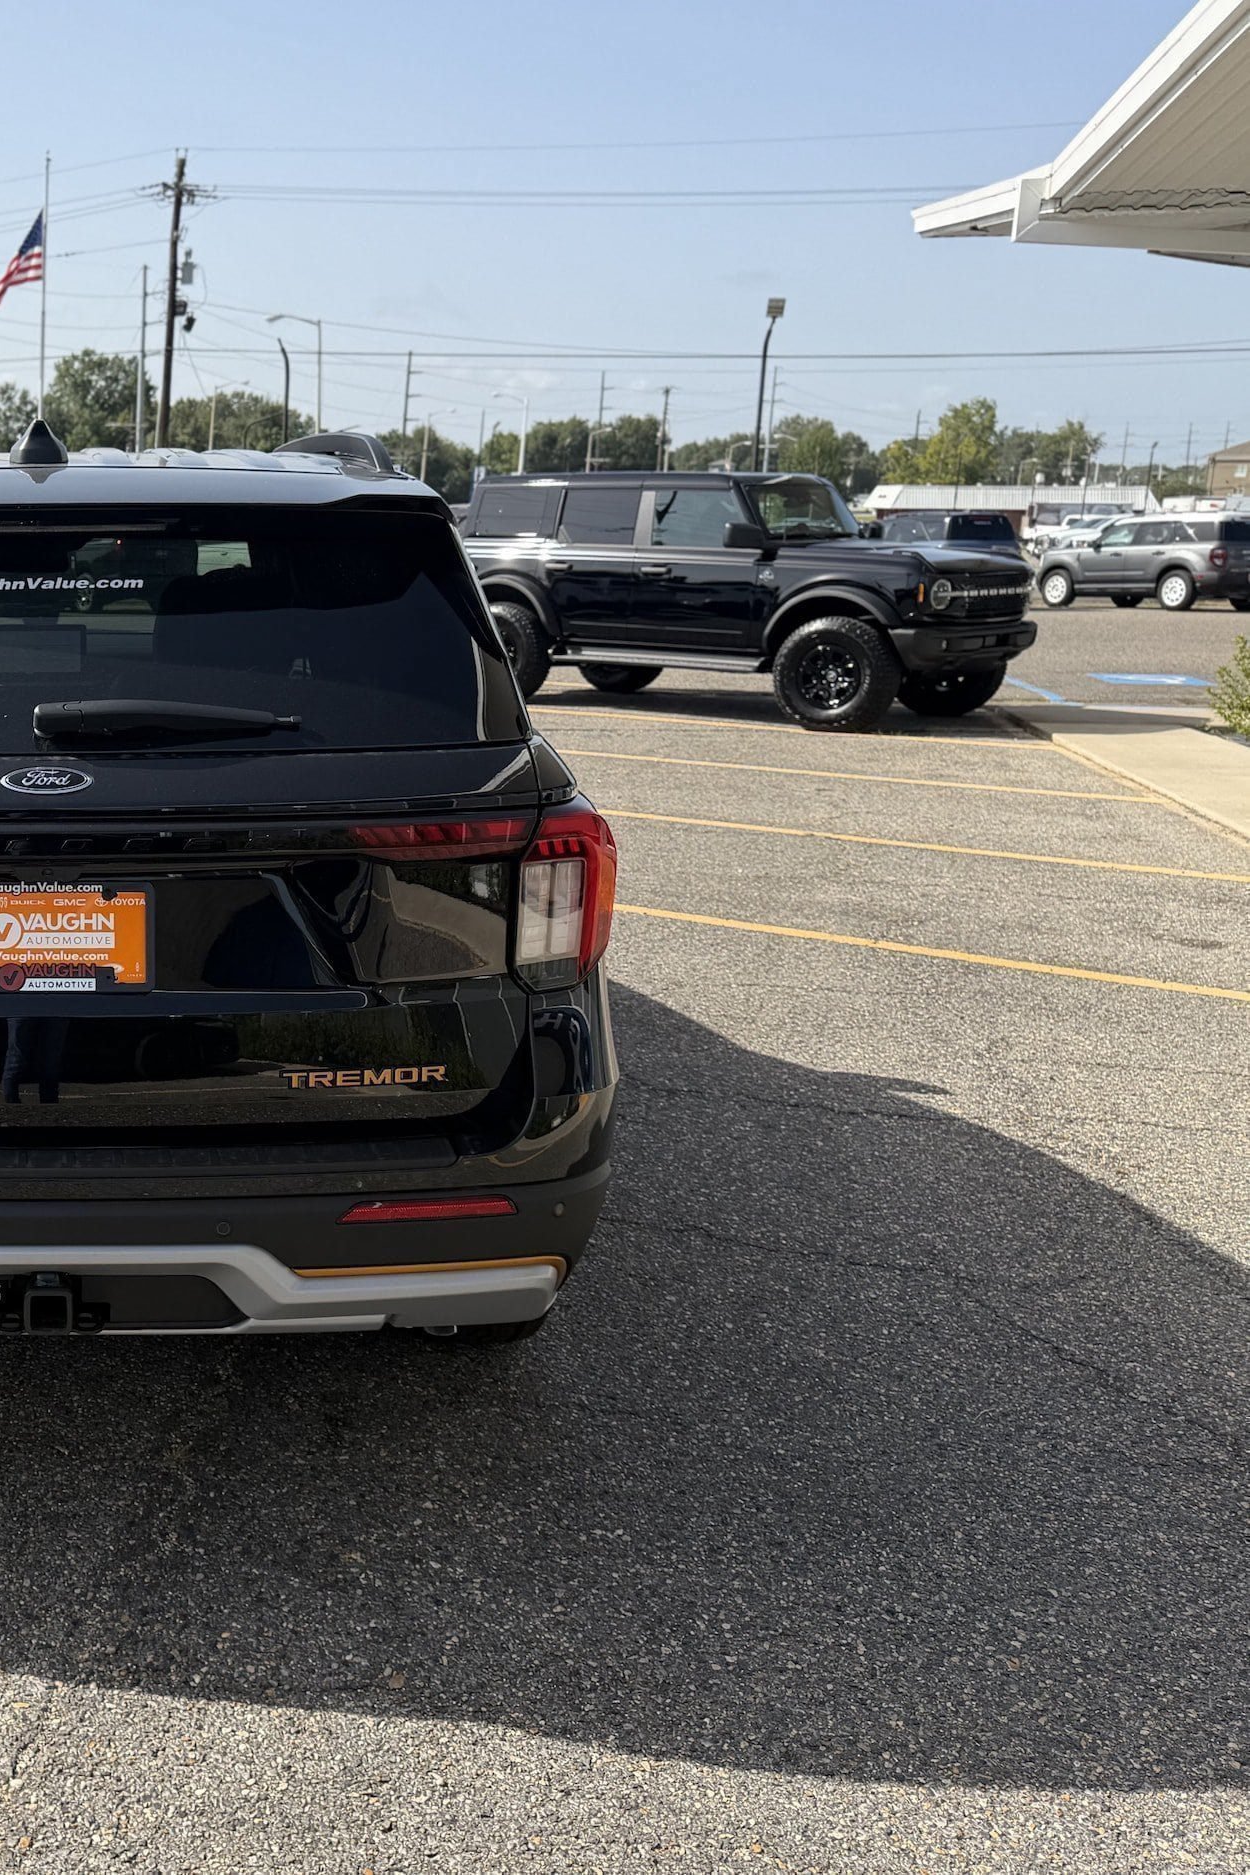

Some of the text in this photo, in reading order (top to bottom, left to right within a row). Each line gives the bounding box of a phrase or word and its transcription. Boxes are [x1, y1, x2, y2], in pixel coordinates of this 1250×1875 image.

[21, 769, 71, 786] Ford
[110, 898, 146, 906] TOYOTA
[18, 913, 114, 931] VAUGHN
[26, 936, 111, 945] AUTOMOTIVE
[22, 963, 96, 977] VAUGHN
[282, 1065, 449, 1089] TREMOR
